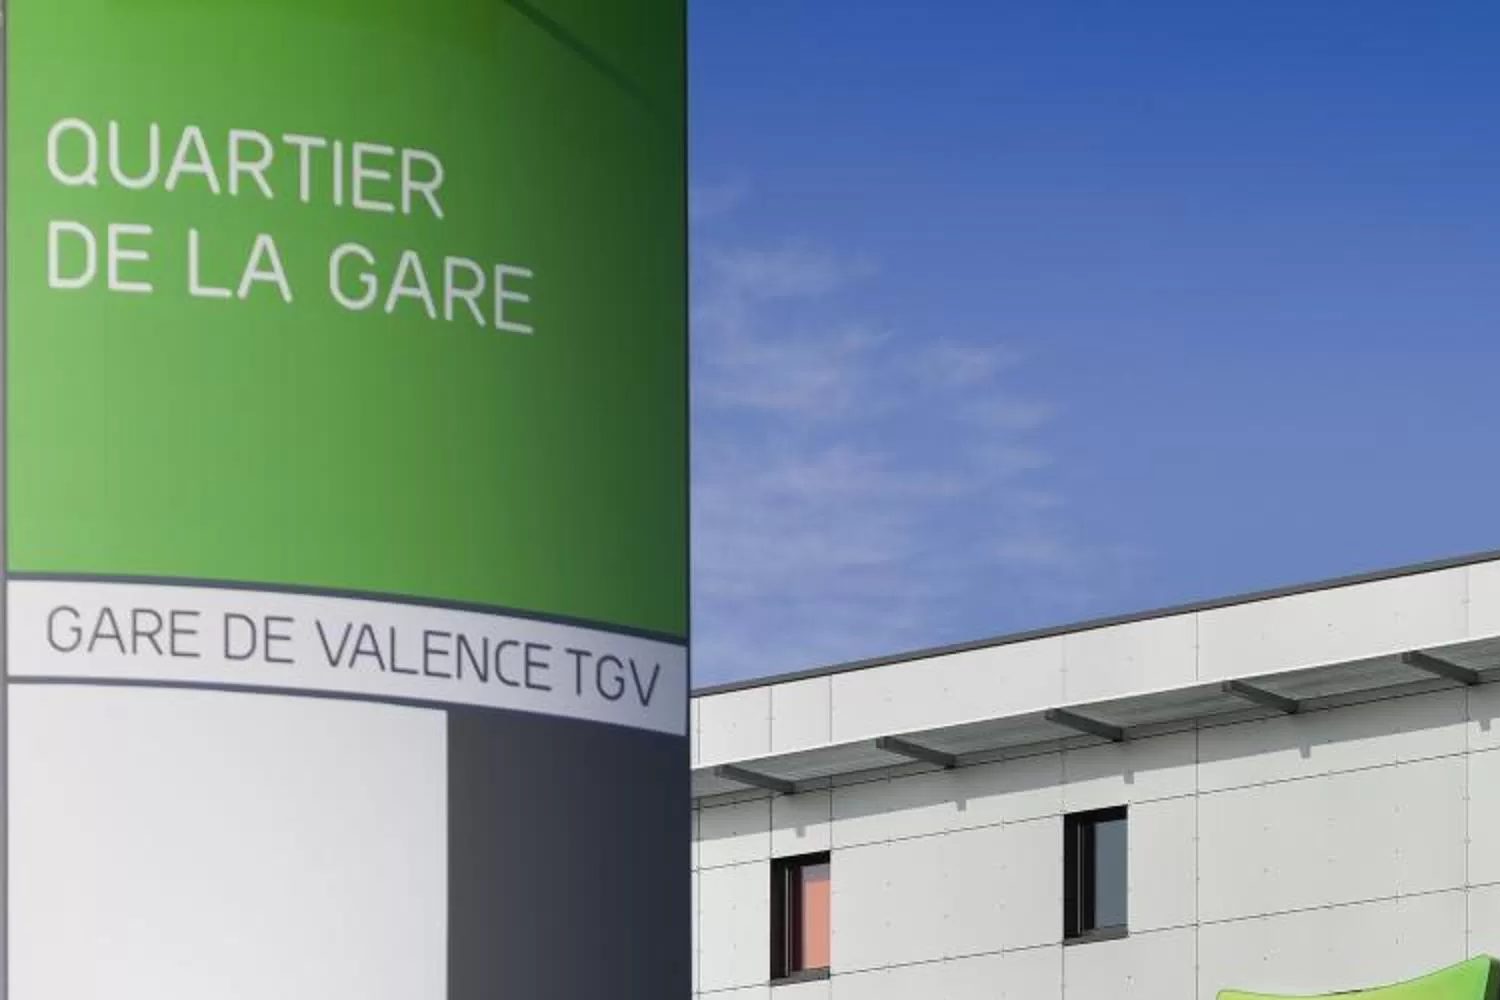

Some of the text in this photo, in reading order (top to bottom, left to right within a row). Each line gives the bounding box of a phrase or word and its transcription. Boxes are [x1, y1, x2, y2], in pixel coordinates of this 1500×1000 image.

[46, 117, 446, 220] QUARTIER
[47, 220, 535, 335] DE LA GARE
[46, 605, 661, 707] GARE DE VALENCE TGV
